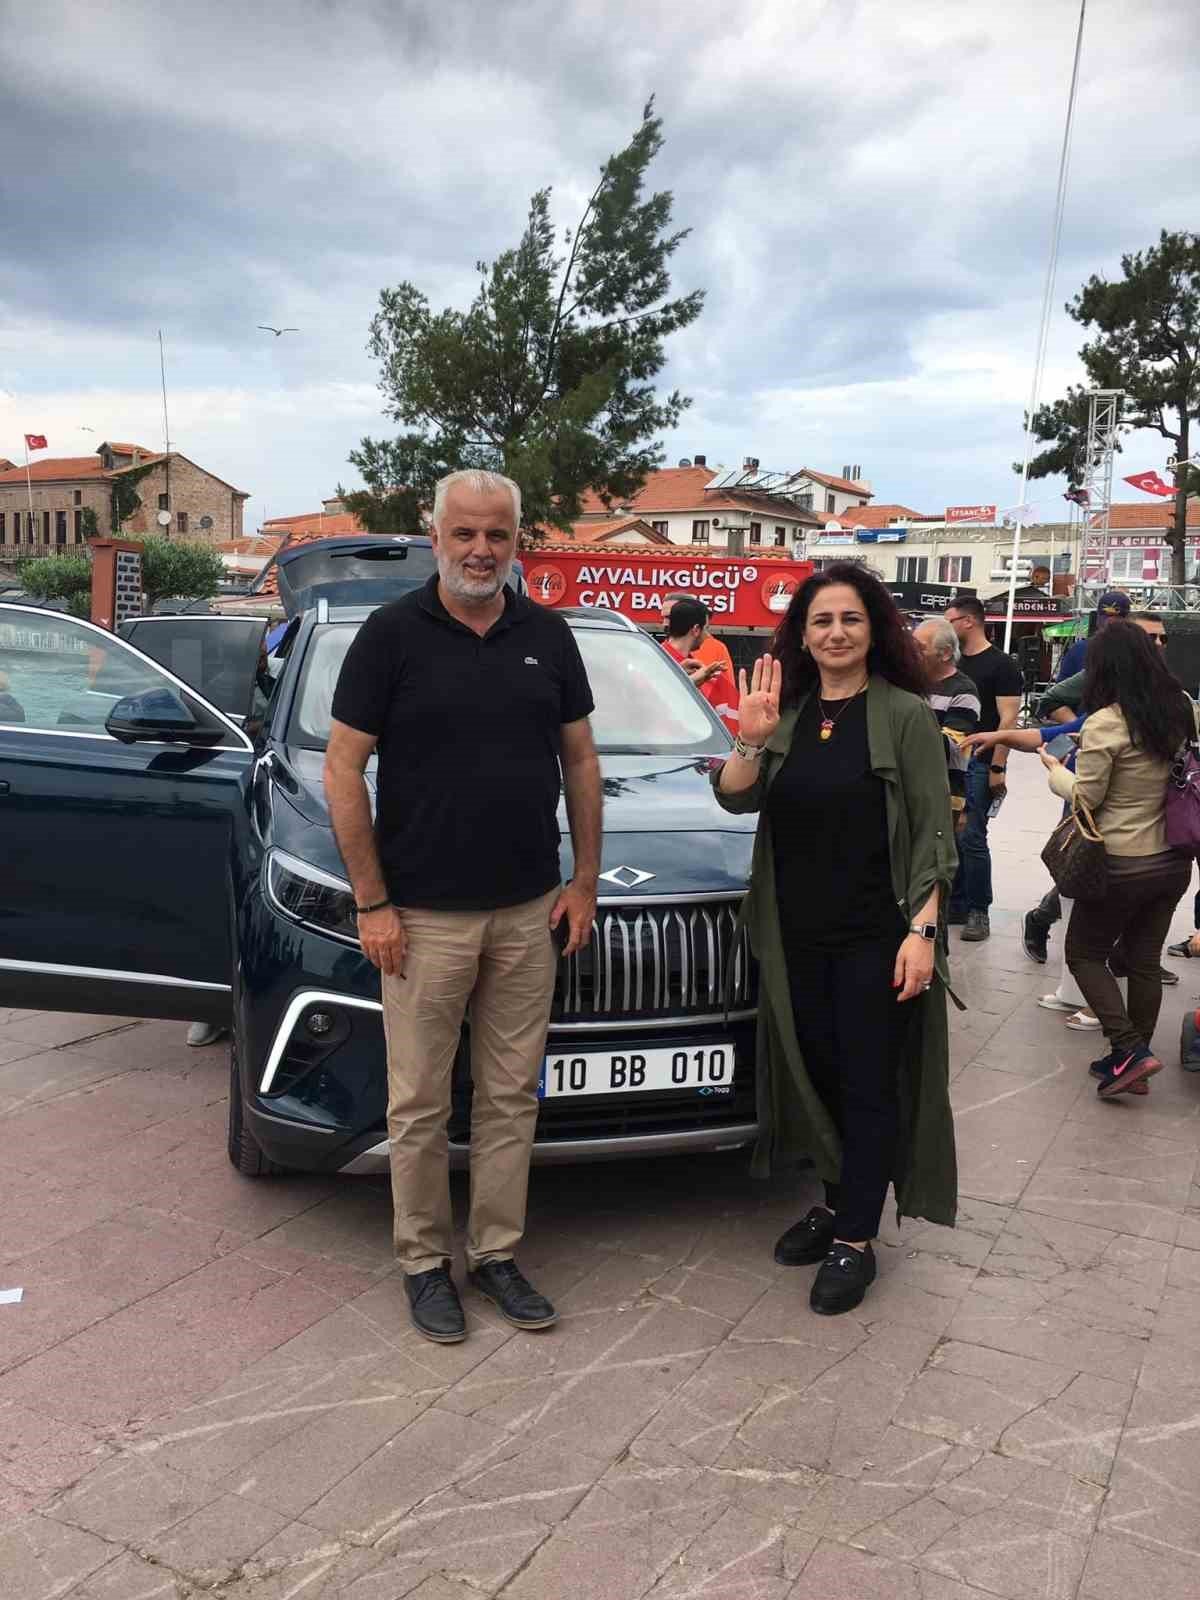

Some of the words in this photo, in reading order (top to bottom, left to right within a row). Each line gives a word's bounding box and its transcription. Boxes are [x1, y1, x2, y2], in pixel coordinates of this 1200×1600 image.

[576, 565, 740, 589] AYVALIKGÜCÜ
[553, 1058, 587, 1092] 10
[610, 1054, 647, 1088] BB
[671, 1049, 725, 1083] 010
